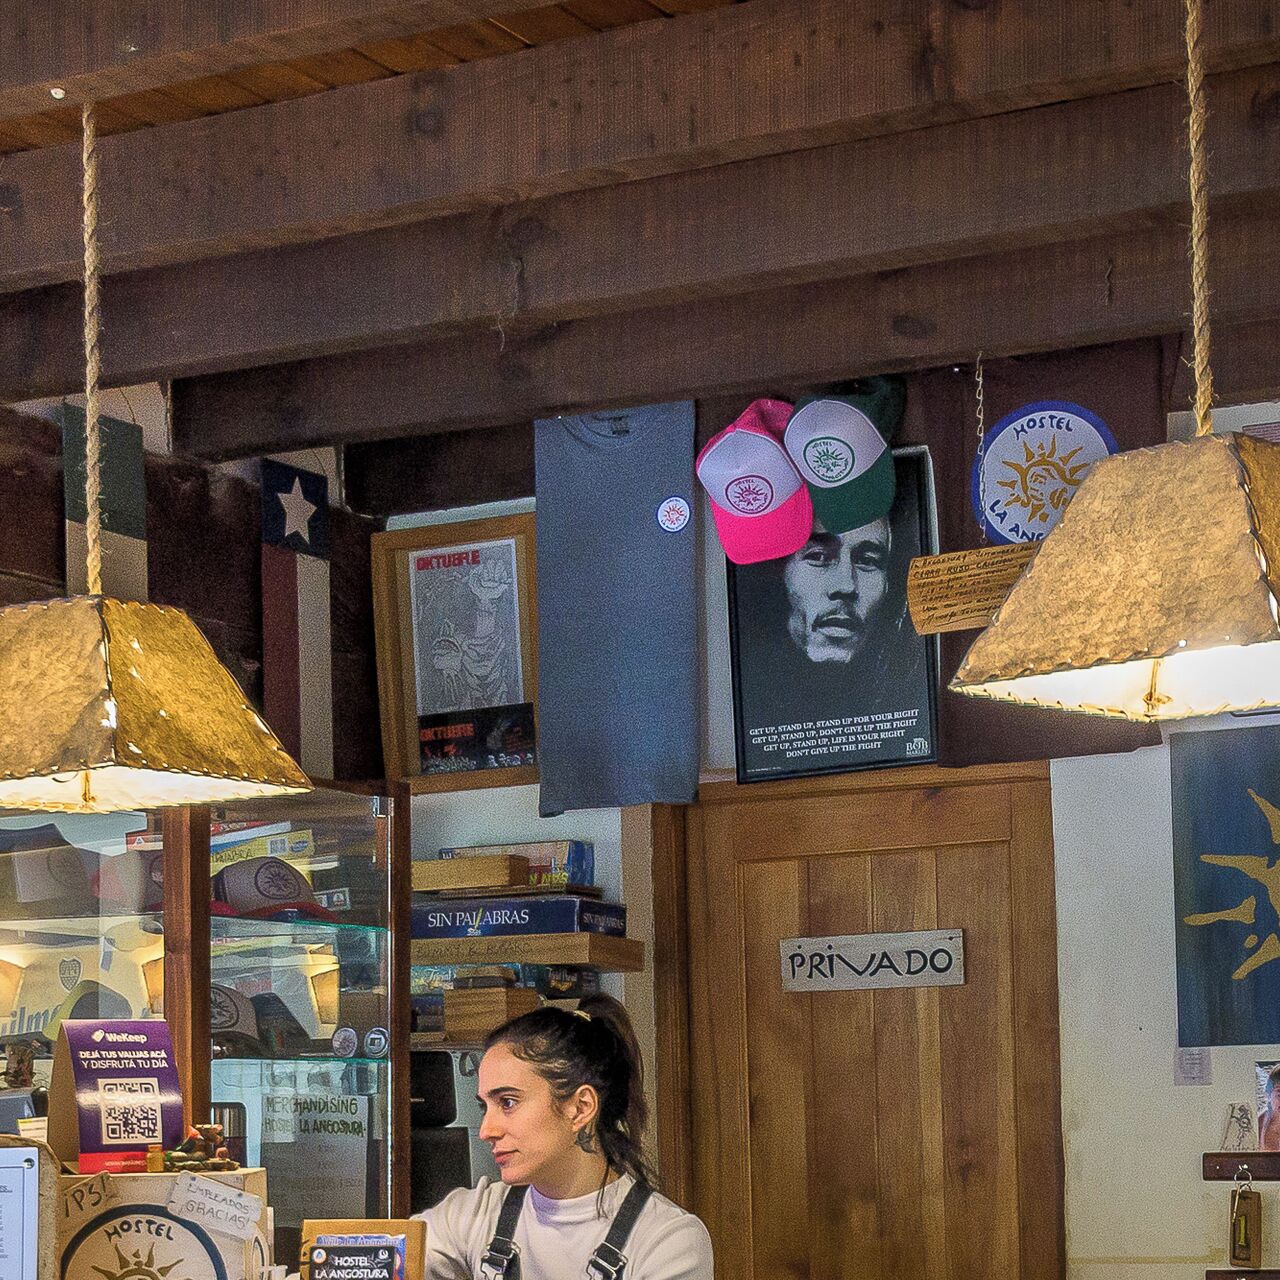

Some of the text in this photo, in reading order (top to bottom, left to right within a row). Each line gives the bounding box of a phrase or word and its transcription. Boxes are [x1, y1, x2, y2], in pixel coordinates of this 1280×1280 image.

[1014, 415, 1073, 439] HOSTEL
[990, 500, 1008, 524] LA
[778, 724, 801, 732] STAND
[816, 720, 840, 728] STAND
[870, 713, 892, 722] YOUR
[894, 709, 919, 719] RIGHT
[428, 909, 529, 928] SIN PALABRAS
[105, 1033, 147, 1044] WeKeep
[79, 1050, 100, 1059] DEJÁ
[150, 1050, 167, 1058] ACÁ
[137, 1060, 150, 1068] TU
[152, 1059, 168, 1068] DÍA
[104, 1218, 174, 1242] HOSTEL
[1238, 1216, 1245, 1246] 1
[335, 1257, 370, 1266] HOSTEL
[315, 1269, 389, 1279] LA ANGOSTURA
